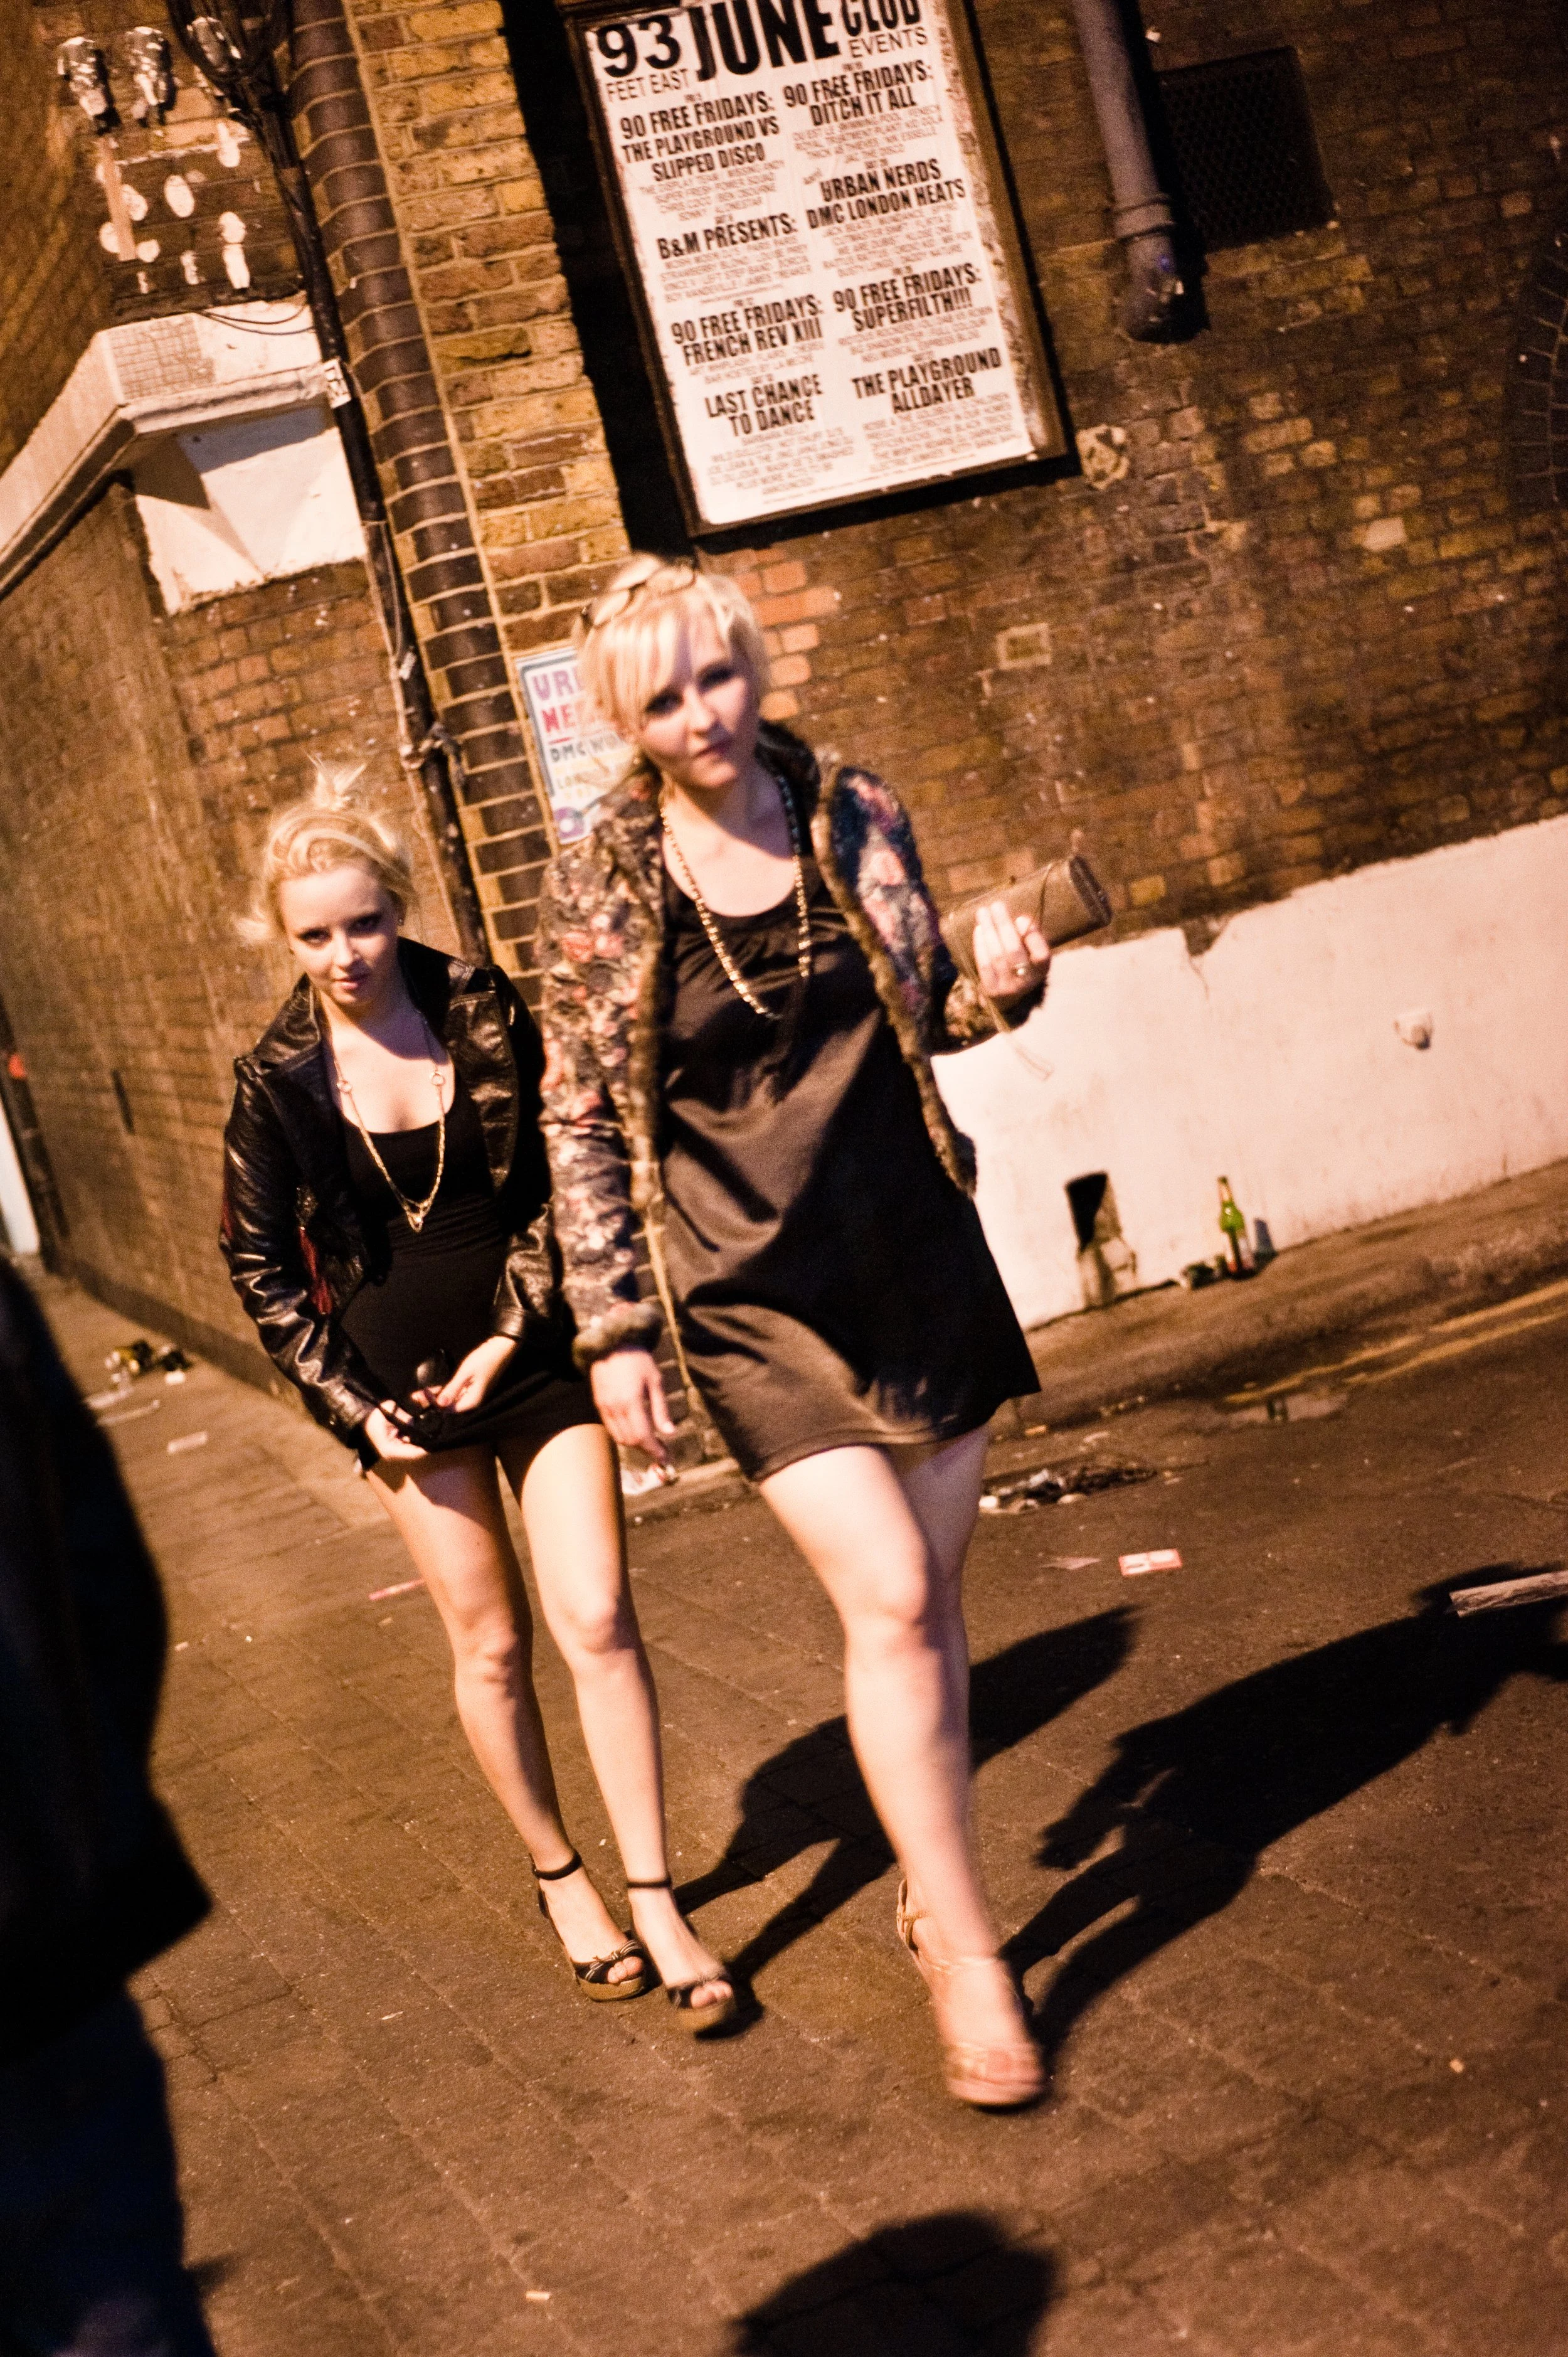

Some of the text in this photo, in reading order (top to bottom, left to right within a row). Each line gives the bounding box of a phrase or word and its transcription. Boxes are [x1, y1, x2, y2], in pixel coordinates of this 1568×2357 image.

[596, 0, 840, 82] 93 JUNE
[849, 27, 928, 58] EVENTS
[606, 68, 690, 102] FEET EAST
[783, 60, 933, 107] 90 FREE FRIDAYS:
[810, 95, 864, 125] DITCH
[866, 92, 882, 114] IT
[887, 85, 917, 110] ALL
[620, 91, 775, 139] 90 FREE FRIDAYS:
[622, 115, 780, 163] THE PLAYGROUND VS
[652, 153, 715, 181] SLIPPED
[718, 142, 765, 169] DISCO
[820, 171, 880, 202] URBAN
[883, 158, 941, 188] NERDS
[807, 203, 846, 229] DMC
[847, 189, 912, 220] LONDON
[915, 178, 966, 206] HEATS
[657, 231, 701, 260] B&M
[833, 288, 856, 312] 90
[860, 279, 900, 306] FREE
[852, 287, 972, 332] SUPERFILTH!!!
[671, 320, 697, 344] 90
[699, 311, 741, 338] FREE
[683, 333, 752, 366] FRENCH
[755, 325, 788, 351] REV
[792, 317, 823, 343] XIII
[852, 373, 885, 399] THE
[887, 347, 1002, 391] PLAYGROUND
[705, 374, 824, 418] LAST CHANCE
[891, 377, 975, 414] ALLDAYER
[729, 399, 815, 437] TO DANCE
